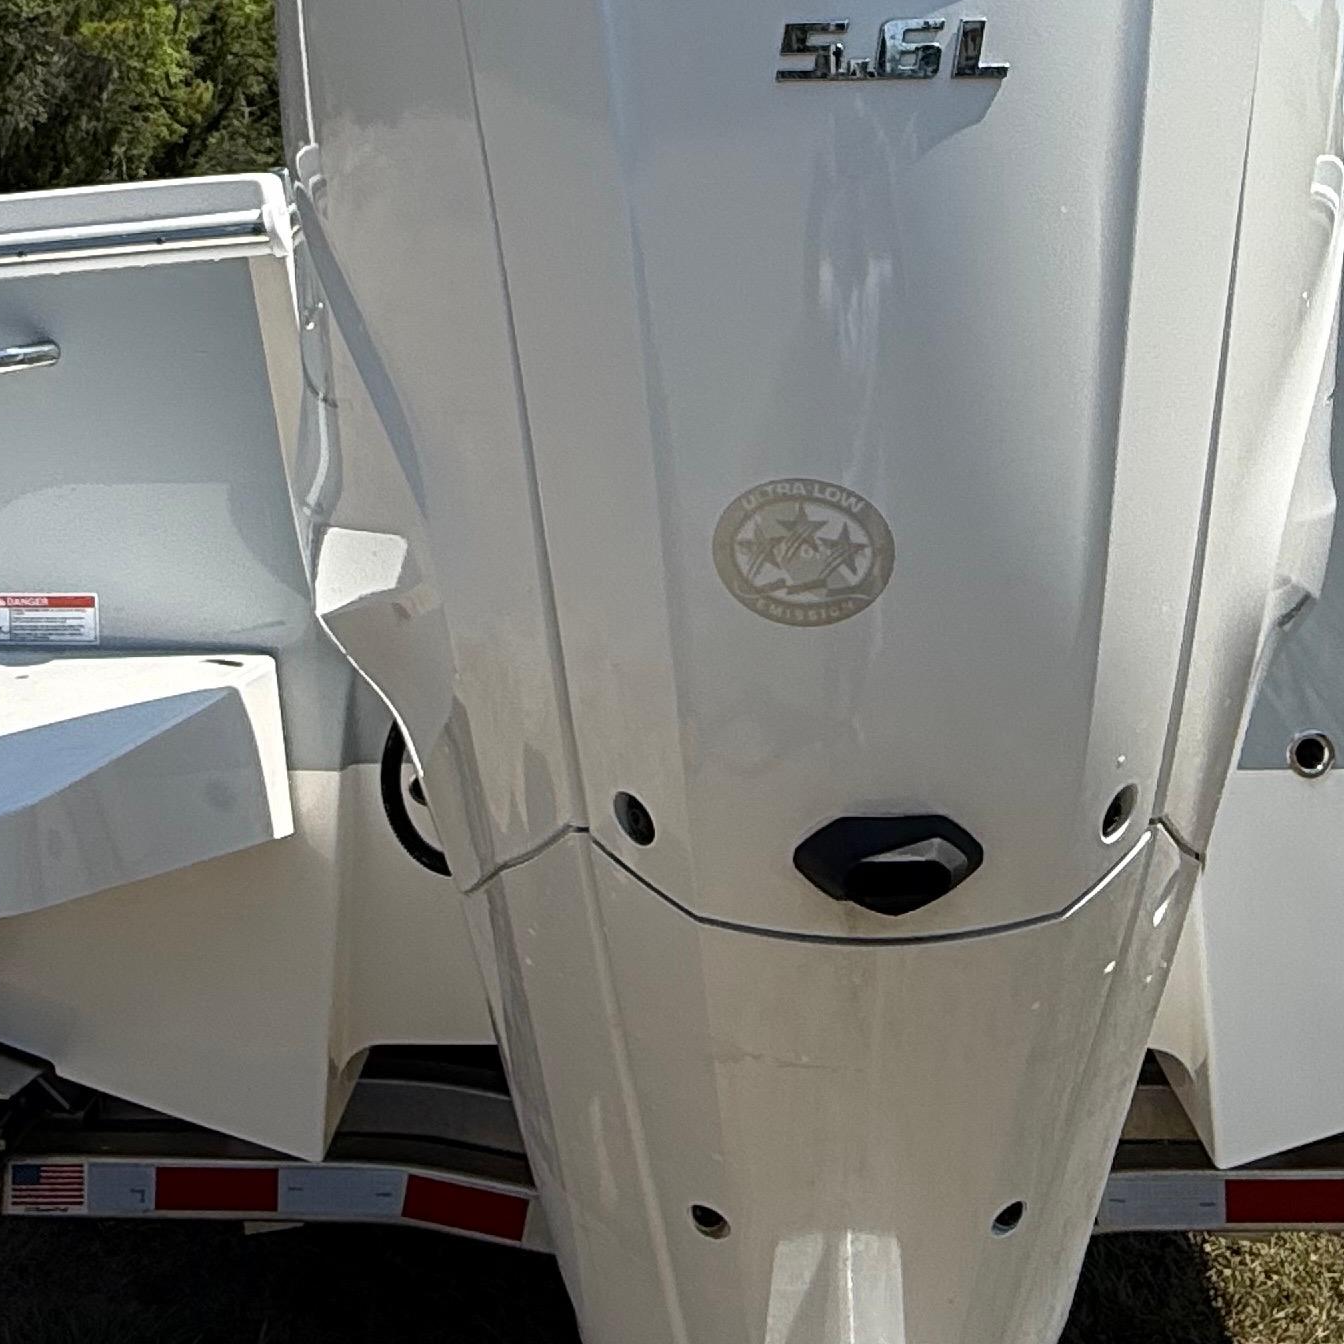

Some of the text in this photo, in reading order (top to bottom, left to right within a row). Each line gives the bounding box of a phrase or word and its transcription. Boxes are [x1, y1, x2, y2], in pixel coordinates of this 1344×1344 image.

[775, 17, 1011, 83] 5.6L
[739, 482, 866, 513] ULTRA LOW
[6, 596, 49, 606] DANGER
[756, 599, 855, 622] EMISSION
